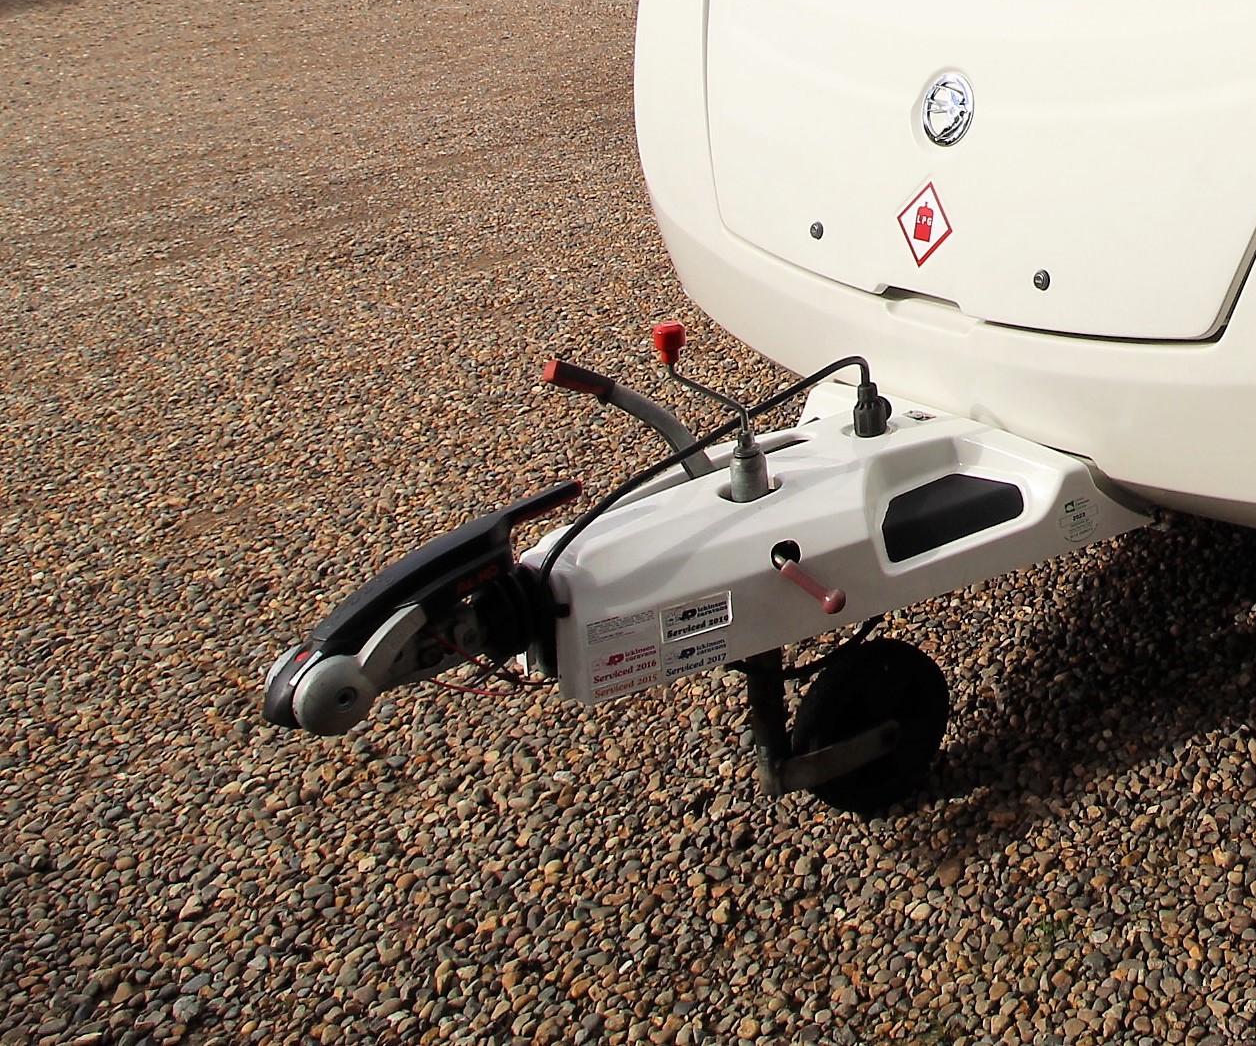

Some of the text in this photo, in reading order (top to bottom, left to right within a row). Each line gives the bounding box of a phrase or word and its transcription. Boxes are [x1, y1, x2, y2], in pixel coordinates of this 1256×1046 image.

[916, 214, 933, 227] LPG
[666, 619, 706, 639] Serviced
[593, 660, 657, 684] Serviced 2016
[665, 653, 727, 677] Serviced 2017
[594, 674, 658, 699] Serviced 2015
